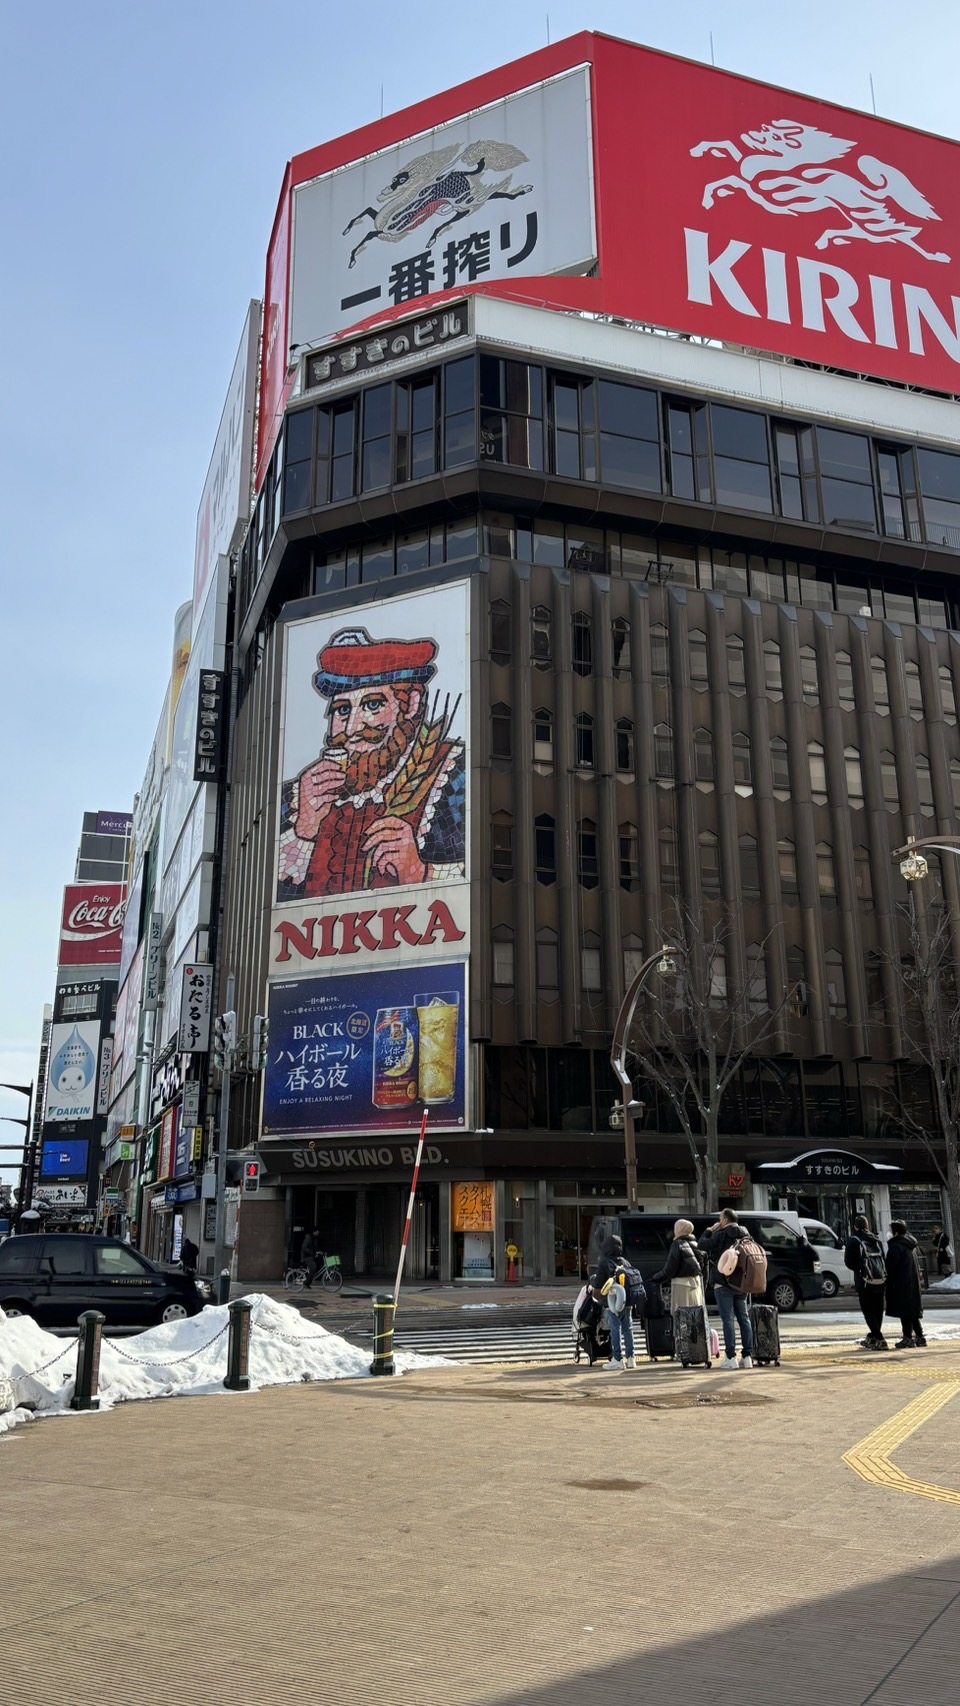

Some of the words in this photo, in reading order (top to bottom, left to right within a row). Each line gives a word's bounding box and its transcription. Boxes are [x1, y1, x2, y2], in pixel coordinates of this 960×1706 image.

[341, 211, 538, 311] 一番搾り
[683, 227, 960, 365] KIRIN
[312, 312, 462, 381] すすきのビル
[197, 673, 221, 774] すすきのビル
[92, 894, 111, 904] Enjoy
[274, 899, 466, 963] NIKKA
[293, 1022, 344, 1039] BLACK
[274, 1043, 362, 1065] ハイボール
[284, 1062, 349, 1091] 香る夜
[56, 1106, 91, 1116] DAIKIN
[292, 1147, 394, 1168] SUSUKINO
[805, 1165, 860, 1175] すすきのビル
[459, 1186, 469, 1228] スクエア
